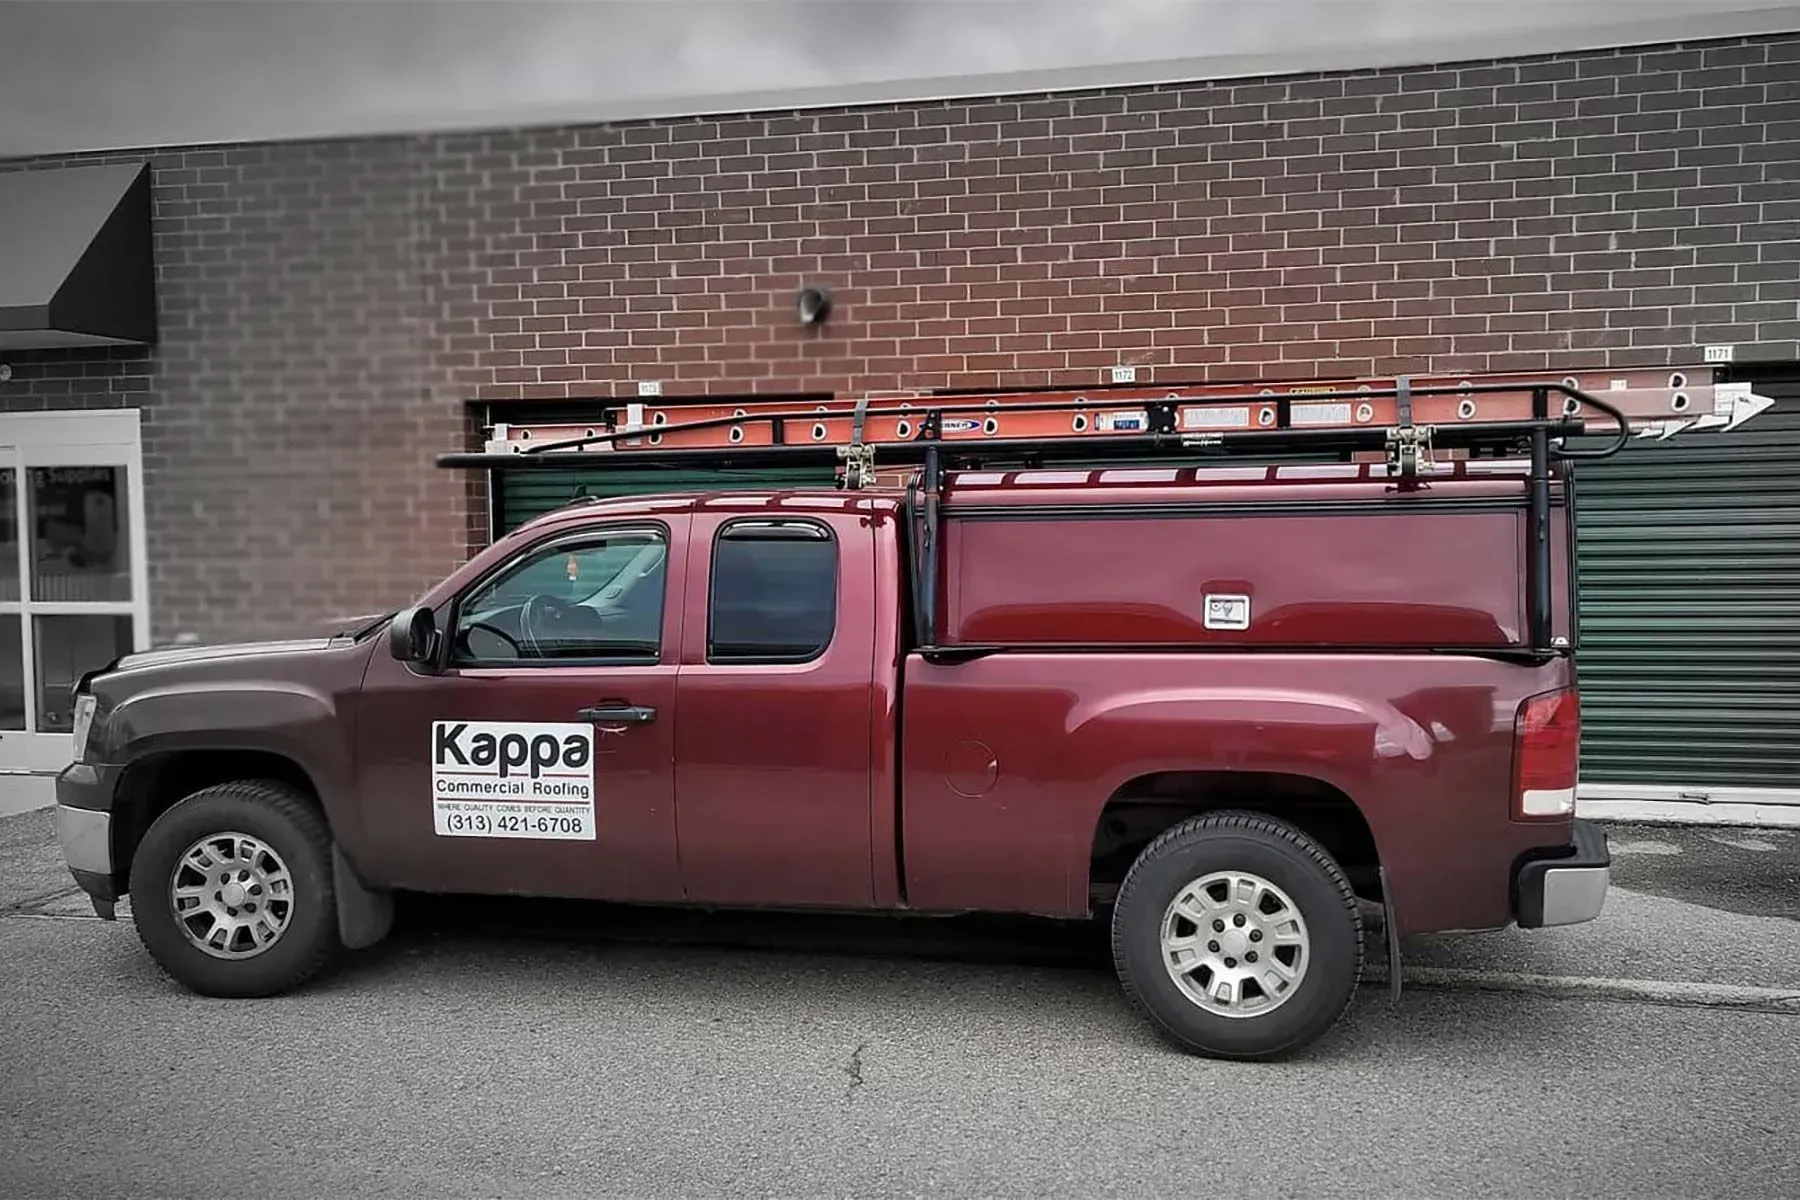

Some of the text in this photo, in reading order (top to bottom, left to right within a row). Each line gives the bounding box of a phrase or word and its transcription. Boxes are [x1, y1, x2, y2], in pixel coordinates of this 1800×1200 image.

[1707, 349, 1729, 360] 1171
[1114, 370, 1133, 380] 1172
[435, 723, 590, 779] Kappa
[436, 779, 590, 799] Commercial Roofing
[437, 803, 590, 815] WHERE QUALITY COMES BEFORE QUANTITY
[447, 814, 583, 834] (313) 421-6708
